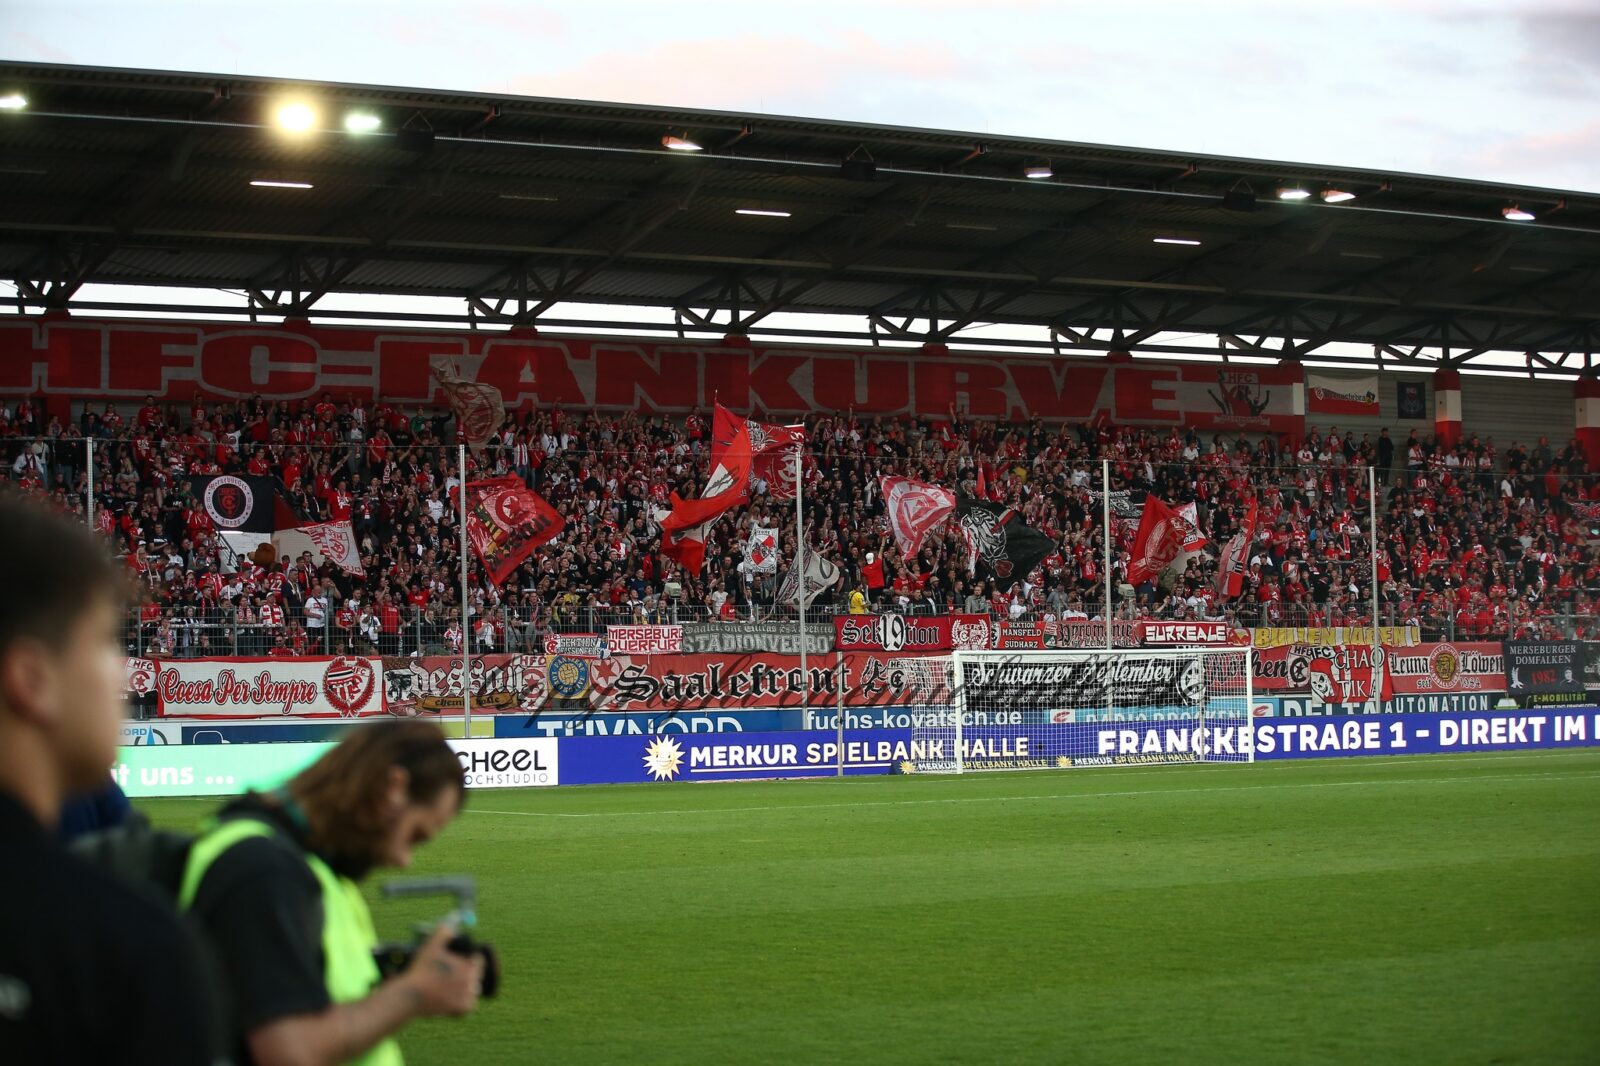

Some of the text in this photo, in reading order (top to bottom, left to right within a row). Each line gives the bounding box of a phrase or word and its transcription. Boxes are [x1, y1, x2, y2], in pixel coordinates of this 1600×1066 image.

[1003, 629, 1042, 637] MANSFELD
[1145, 625, 1227, 642] SURREALE
[1005, 639, 1038, 648] SÜDHARZ
[1509, 645, 1577, 654] MERSEBURGER
[133, 660, 153, 670] HFC
[1389, 651, 1504, 674] Leuna Löwen
[1515, 655, 1571, 665] DOMFALKEN
[215, 669, 251, 704] Per
[251, 670, 317, 714] Sempre
[613, 664, 853, 702] Saalefront
[1385, 695, 1488, 714] AUTOMATION
[806, 710, 1022, 729] fuchs-kovatsch.de
[1389, 722, 1407, 748] 1
[1439, 717, 1546, 746] DIREKT
[1554, 715, 1586, 741] IM
[690, 737, 1028, 768] MERKUR SPIELBANK HALLE
[1074, 752, 1197, 766] MERKUR SPIELBANK HALLE
[918, 761, 958, 771] MERKUR
[1018, 759, 1048, 767] HALLE
[141, 766, 194, 786] uns
[464, 773, 548, 785] OCHSTUDIO
